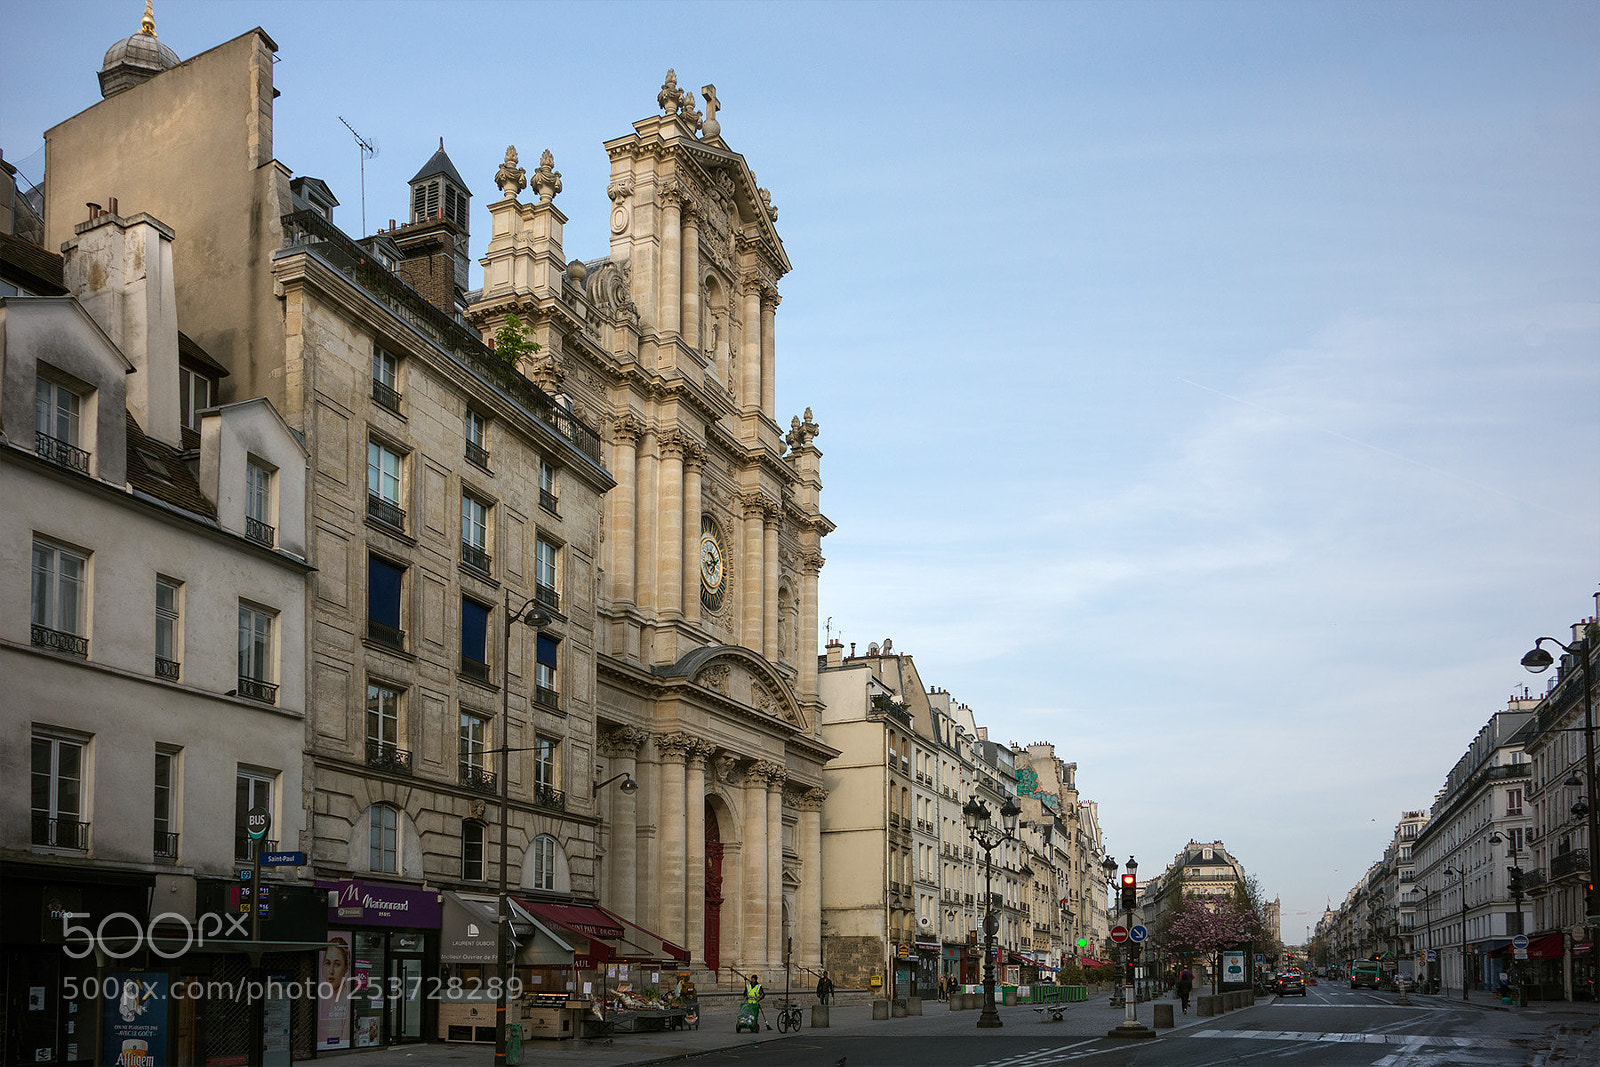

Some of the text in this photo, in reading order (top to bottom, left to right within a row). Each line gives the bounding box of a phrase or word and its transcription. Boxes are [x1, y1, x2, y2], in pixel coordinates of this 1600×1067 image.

[249, 815, 265, 826] BUS
[268, 855, 295, 863] Saint-Paul
[241, 887, 250, 895] 76
[362, 894, 409, 911] Marionnaud
[574, 960, 591, 968] AUL
[115, 1053, 154, 1067] Affligem
